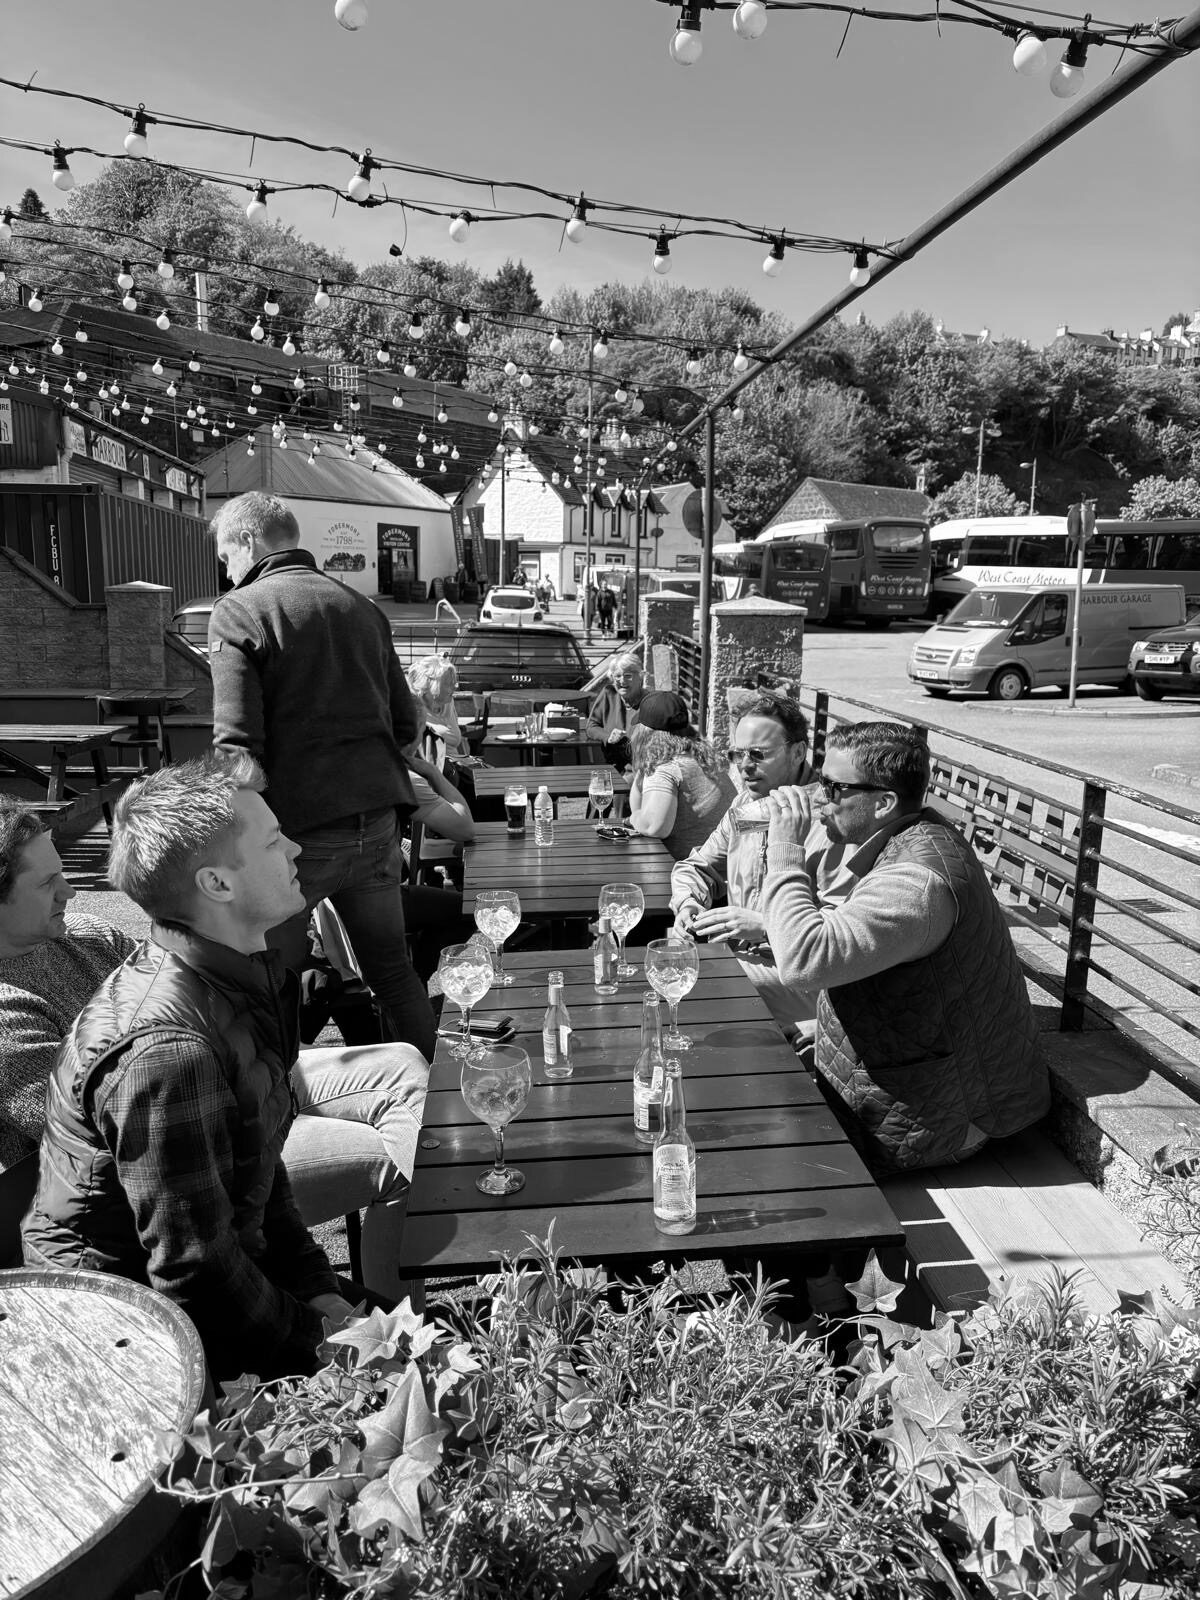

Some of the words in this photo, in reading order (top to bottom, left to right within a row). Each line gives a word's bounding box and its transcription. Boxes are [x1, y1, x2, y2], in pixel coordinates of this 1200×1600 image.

[94, 437, 126, 469] HARBOUR
[327, 522, 361, 537] TOBERMORY
[382, 528, 411, 542] TOBERMORY
[50, 524, 59, 571] FCBU
[336, 535, 353, 545] 1798
[977, 569, 1001, 583] West
[1003, 571, 1031, 584] Coast
[1031, 573, 1067, 585] Motors
[1080, 594, 1119, 605] HARBOUR
[1120, 593, 1153, 604] GARAGE
